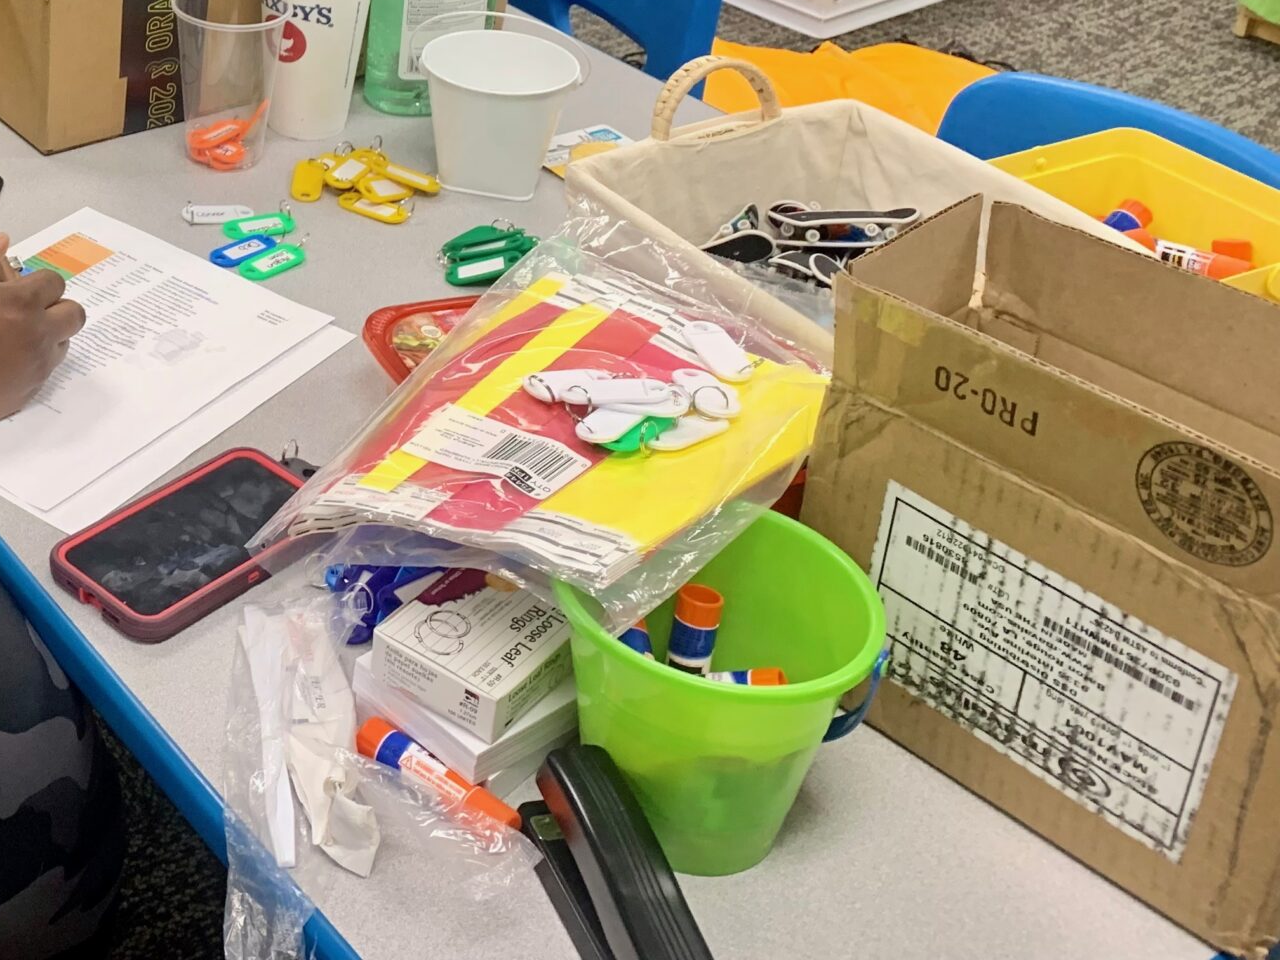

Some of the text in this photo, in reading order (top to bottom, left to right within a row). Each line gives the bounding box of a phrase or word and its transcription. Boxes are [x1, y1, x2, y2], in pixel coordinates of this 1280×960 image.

[934, 365, 1038, 437] PRO-20
[509, 605, 546, 632] Rings
[500, 614, 563, 667] Loose Leaf
[937, 640, 967, 664] 48
